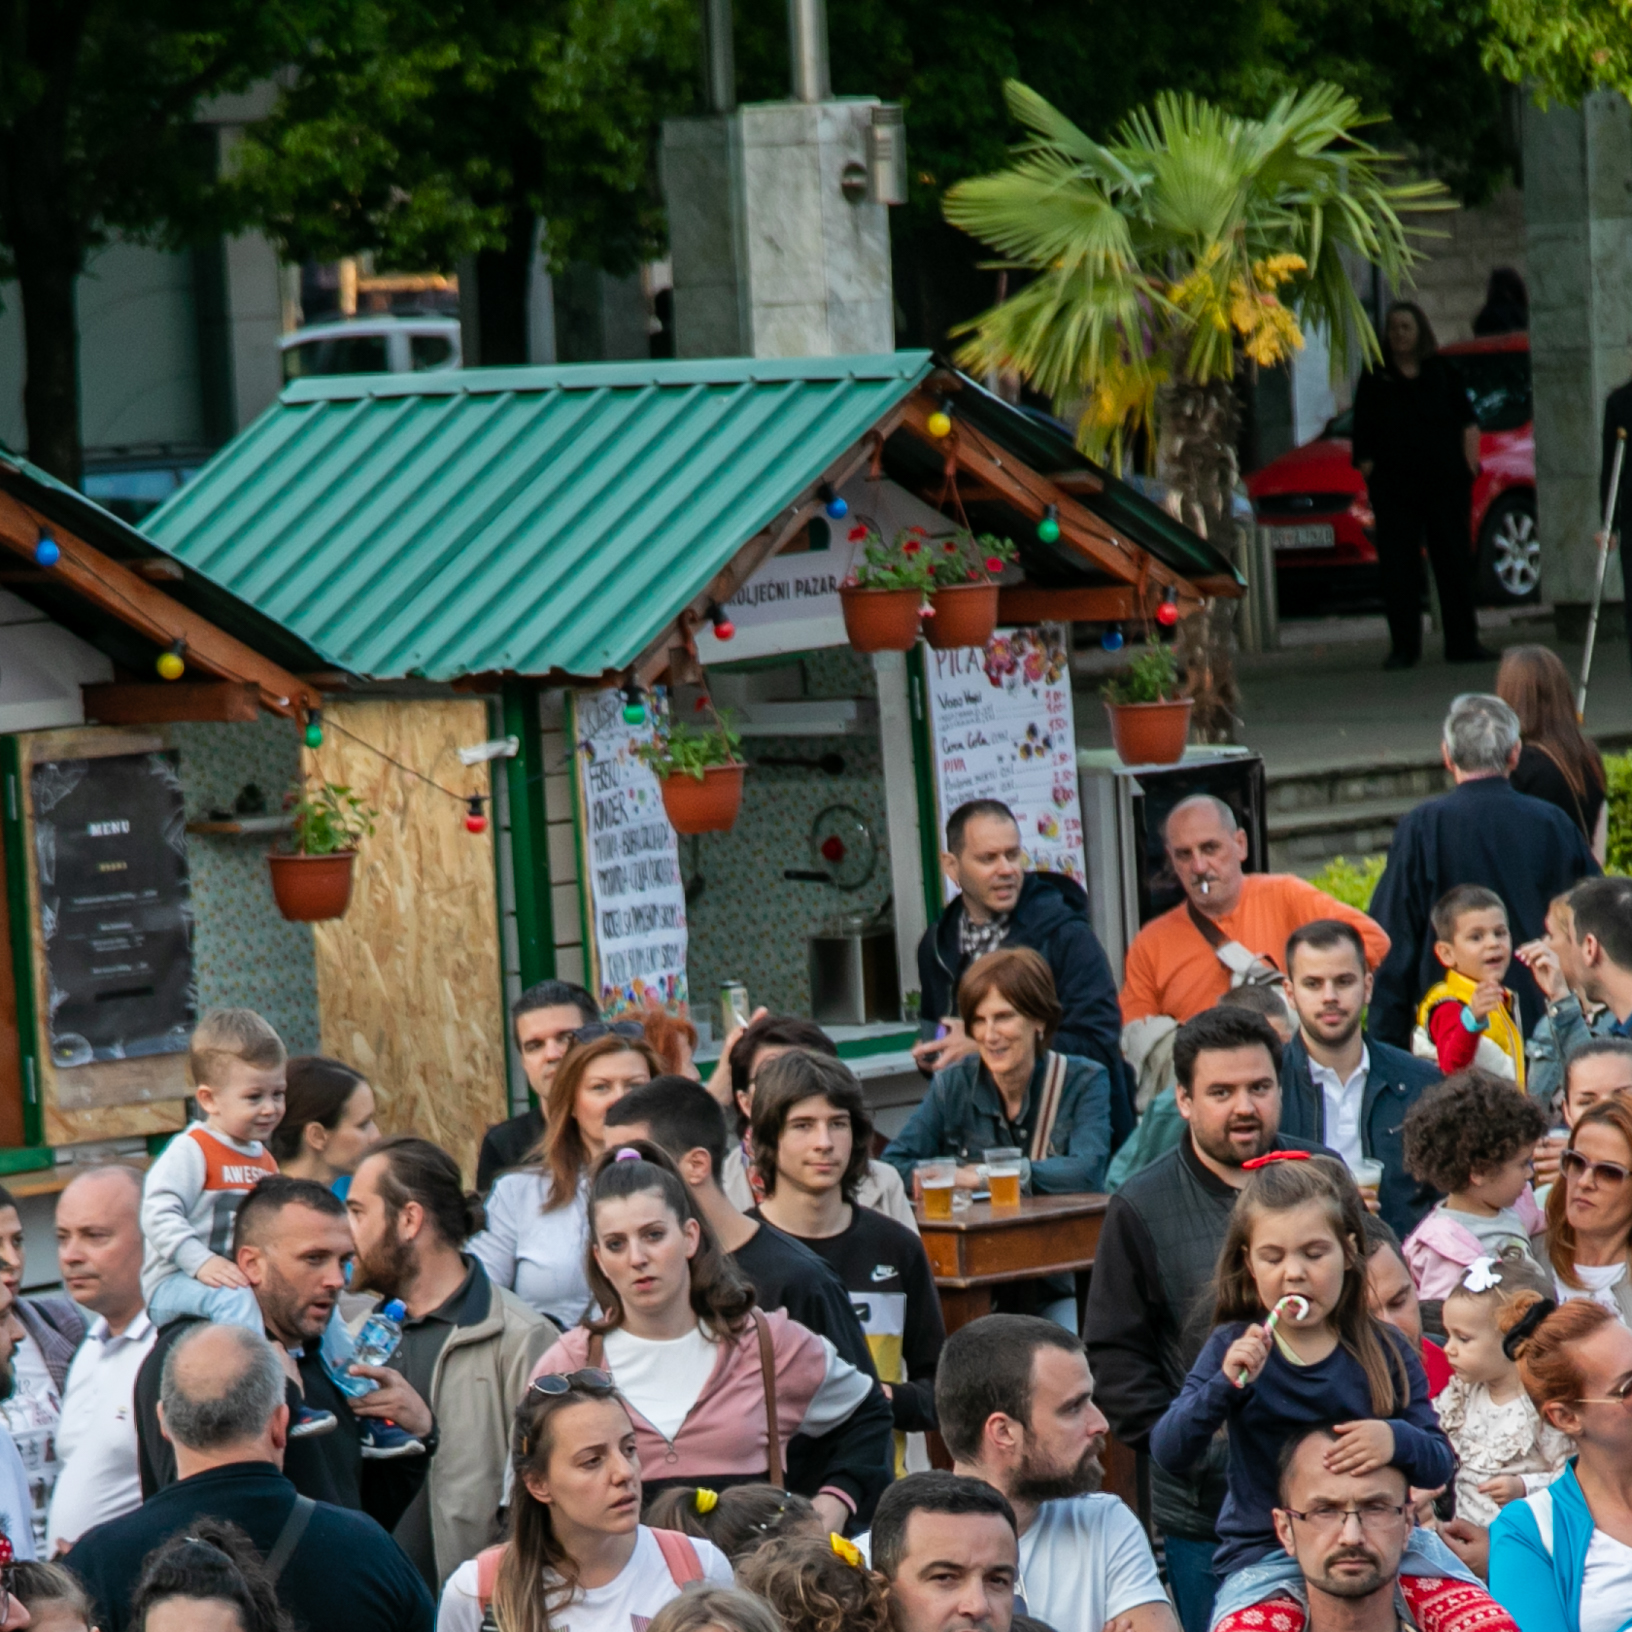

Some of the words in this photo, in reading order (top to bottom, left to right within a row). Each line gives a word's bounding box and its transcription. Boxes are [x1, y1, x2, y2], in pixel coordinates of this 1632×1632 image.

[729, 578, 790, 608] OLJEĆNI
[796, 575, 837, 598] PAZAR
[89, 820, 130, 837] MENU
[222, 1165, 274, 1184] AWES
